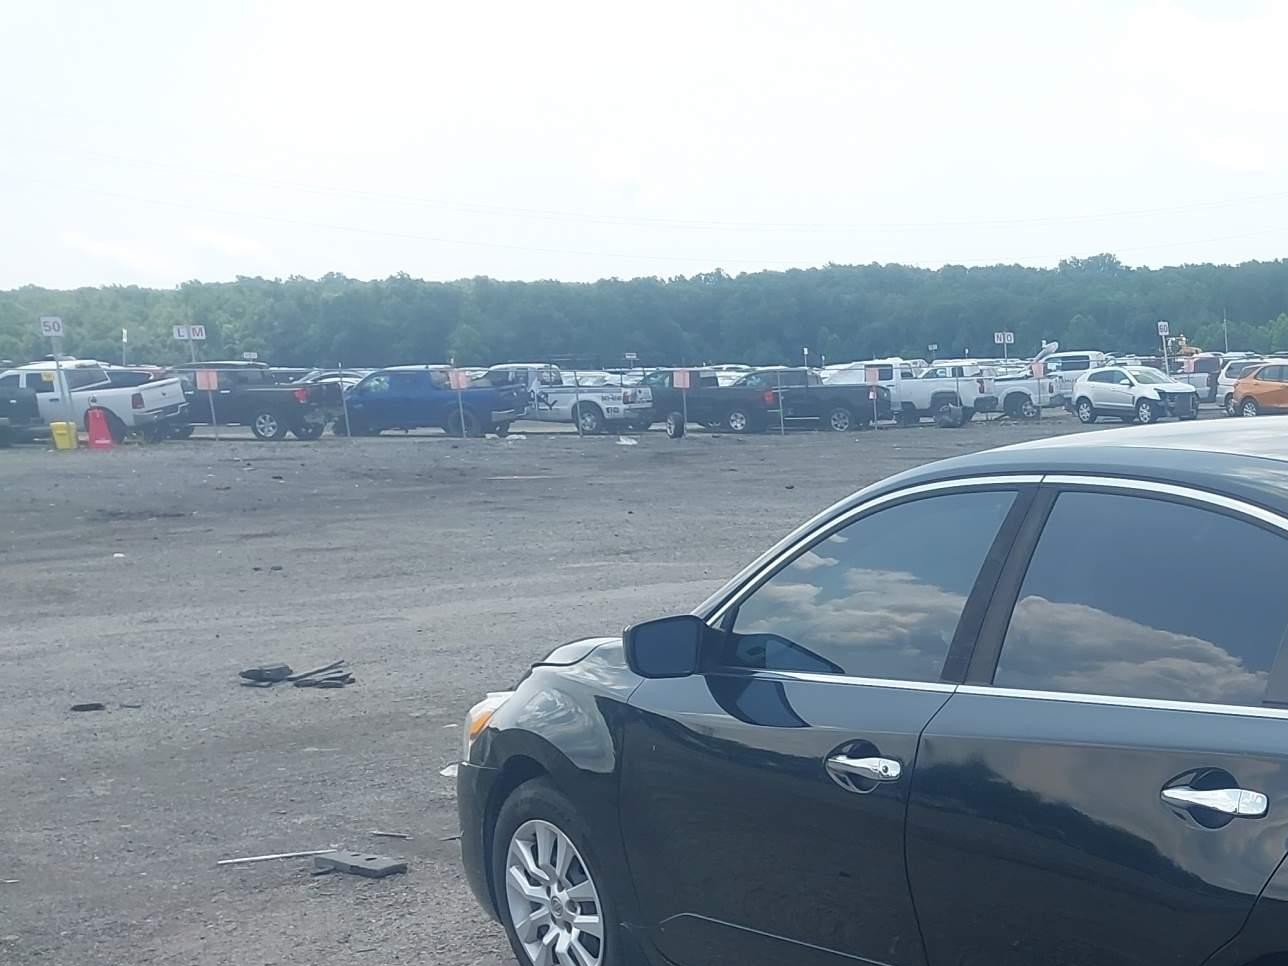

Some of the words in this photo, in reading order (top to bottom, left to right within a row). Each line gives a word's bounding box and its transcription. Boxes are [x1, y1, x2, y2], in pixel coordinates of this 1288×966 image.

[42, 320, 61, 333] 50
[177, 327, 185, 338] L
[191, 327, 204, 337] M
